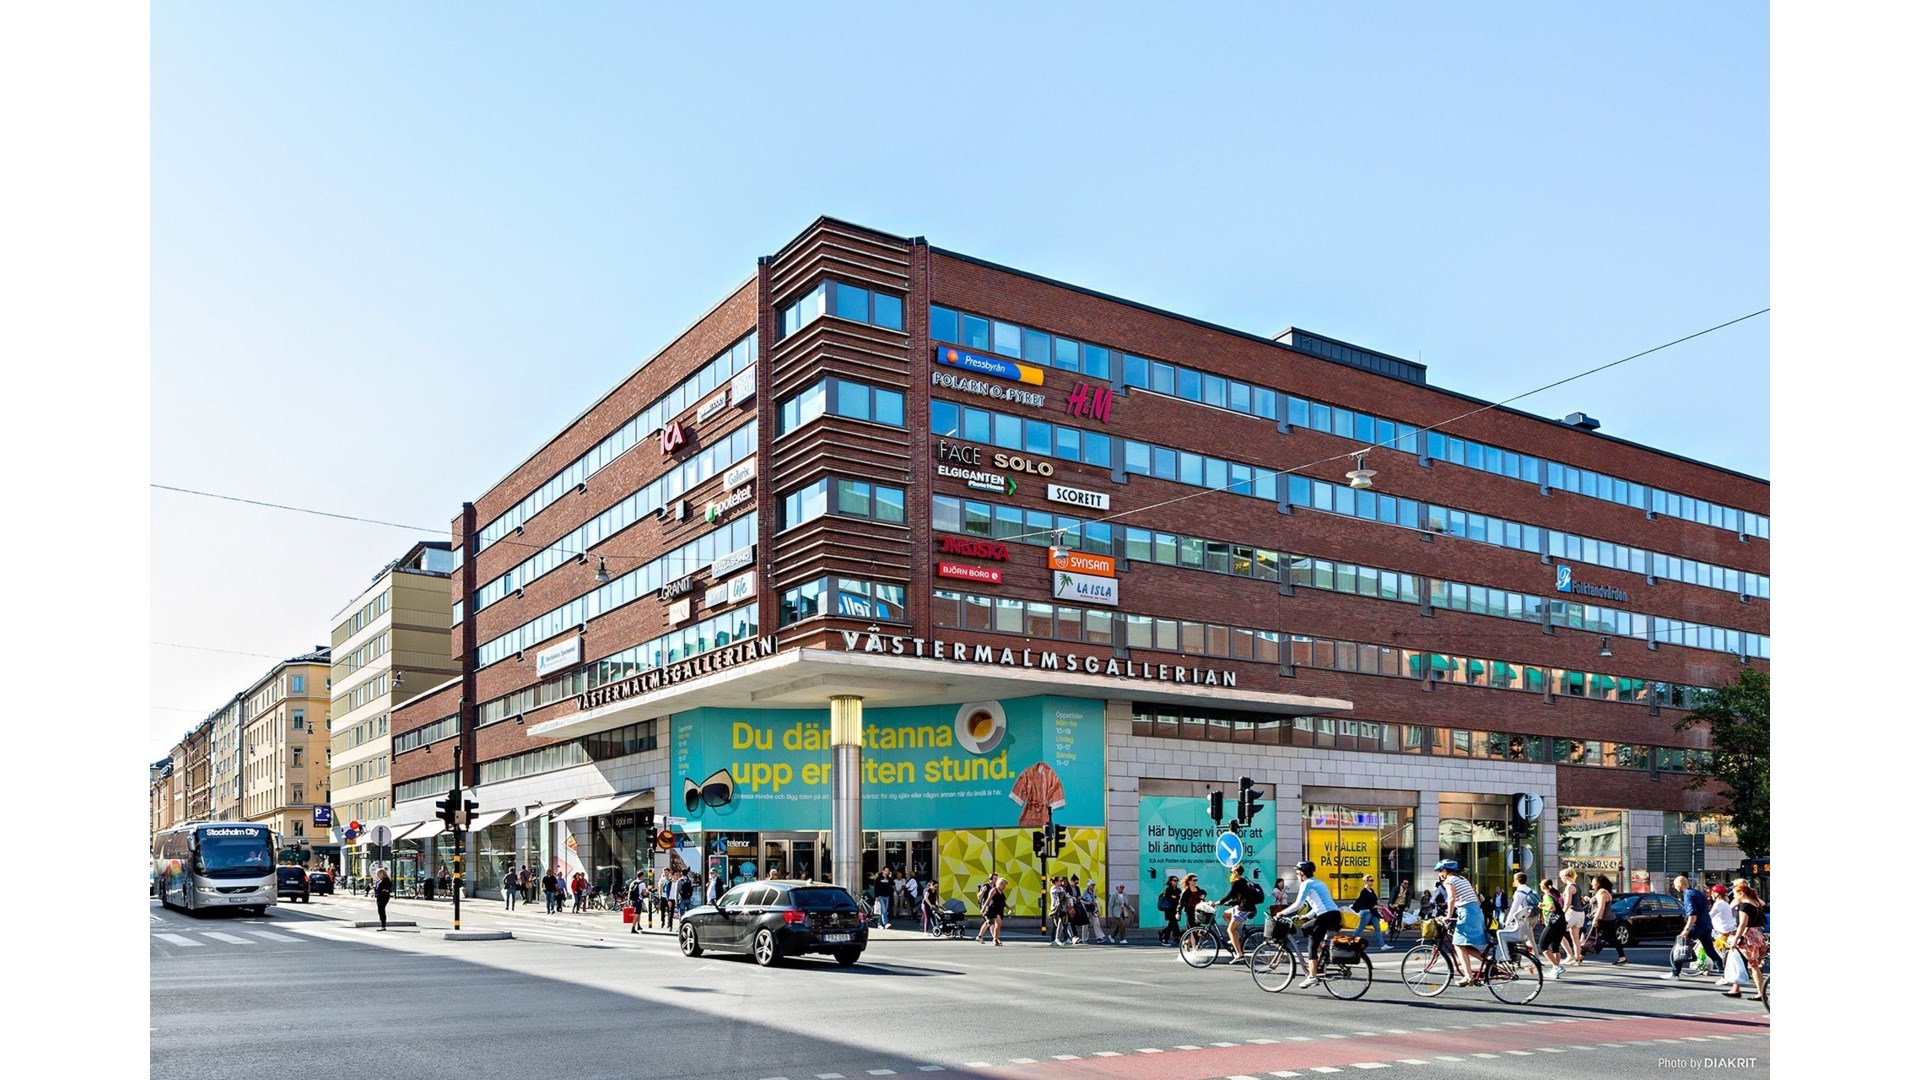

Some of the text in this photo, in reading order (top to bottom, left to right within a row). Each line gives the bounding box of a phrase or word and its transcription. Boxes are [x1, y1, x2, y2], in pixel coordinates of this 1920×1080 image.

[964, 355, 1006, 373] Pressbyrån
[932, 372, 989, 395] POLARN
[1006, 388, 1045, 407] PYRET
[1067, 381, 1112, 424] H&M
[660, 420, 684, 456] ICA
[940, 440, 981, 466] FACE
[994, 453, 1054, 476] SOLO
[938, 465, 1004, 485] ELGIGANTEN
[713, 485, 752, 517] apoteket
[1056, 487, 1102, 507] SCORETT
[942, 565, 990, 579] BJÖRN BORG
[1071, 557, 1110, 572] SYNSAM
[661, 576, 691, 600] GRANIT
[733, 577, 748, 598] life
[1077, 582, 1112, 597] LA ISLA
[842, 623, 1237, 687] VÄSTERMALMSGALLERIAN
[576, 639, 773, 710] VÄSTERMALMSGALLERIAN
[732, 722, 773, 750] Du
[732, 762, 793, 793] upp
[861, 755, 914, 784] iten
[924, 750, 1015, 782] stund.
[206, 828, 259, 837] Stockholm City
[1148, 825, 1165, 837] Här
[1168, 826, 1202, 840] bygger
[1205, 826, 1214, 838] vi
[1237, 826, 1247, 839] ör
[1249, 827, 1263, 839] att
[726, 839, 750, 848] telenor
[1148, 841, 1160, 853] bli
[1163, 841, 1188, 853] ännu
[1243, 842, 1256, 857] ig.
[1324, 837, 1367, 852] VI HÅLLER
[1320, 852, 1371, 867] PÅ SVERIGE!
[1751, 864, 1758, 874] 3
